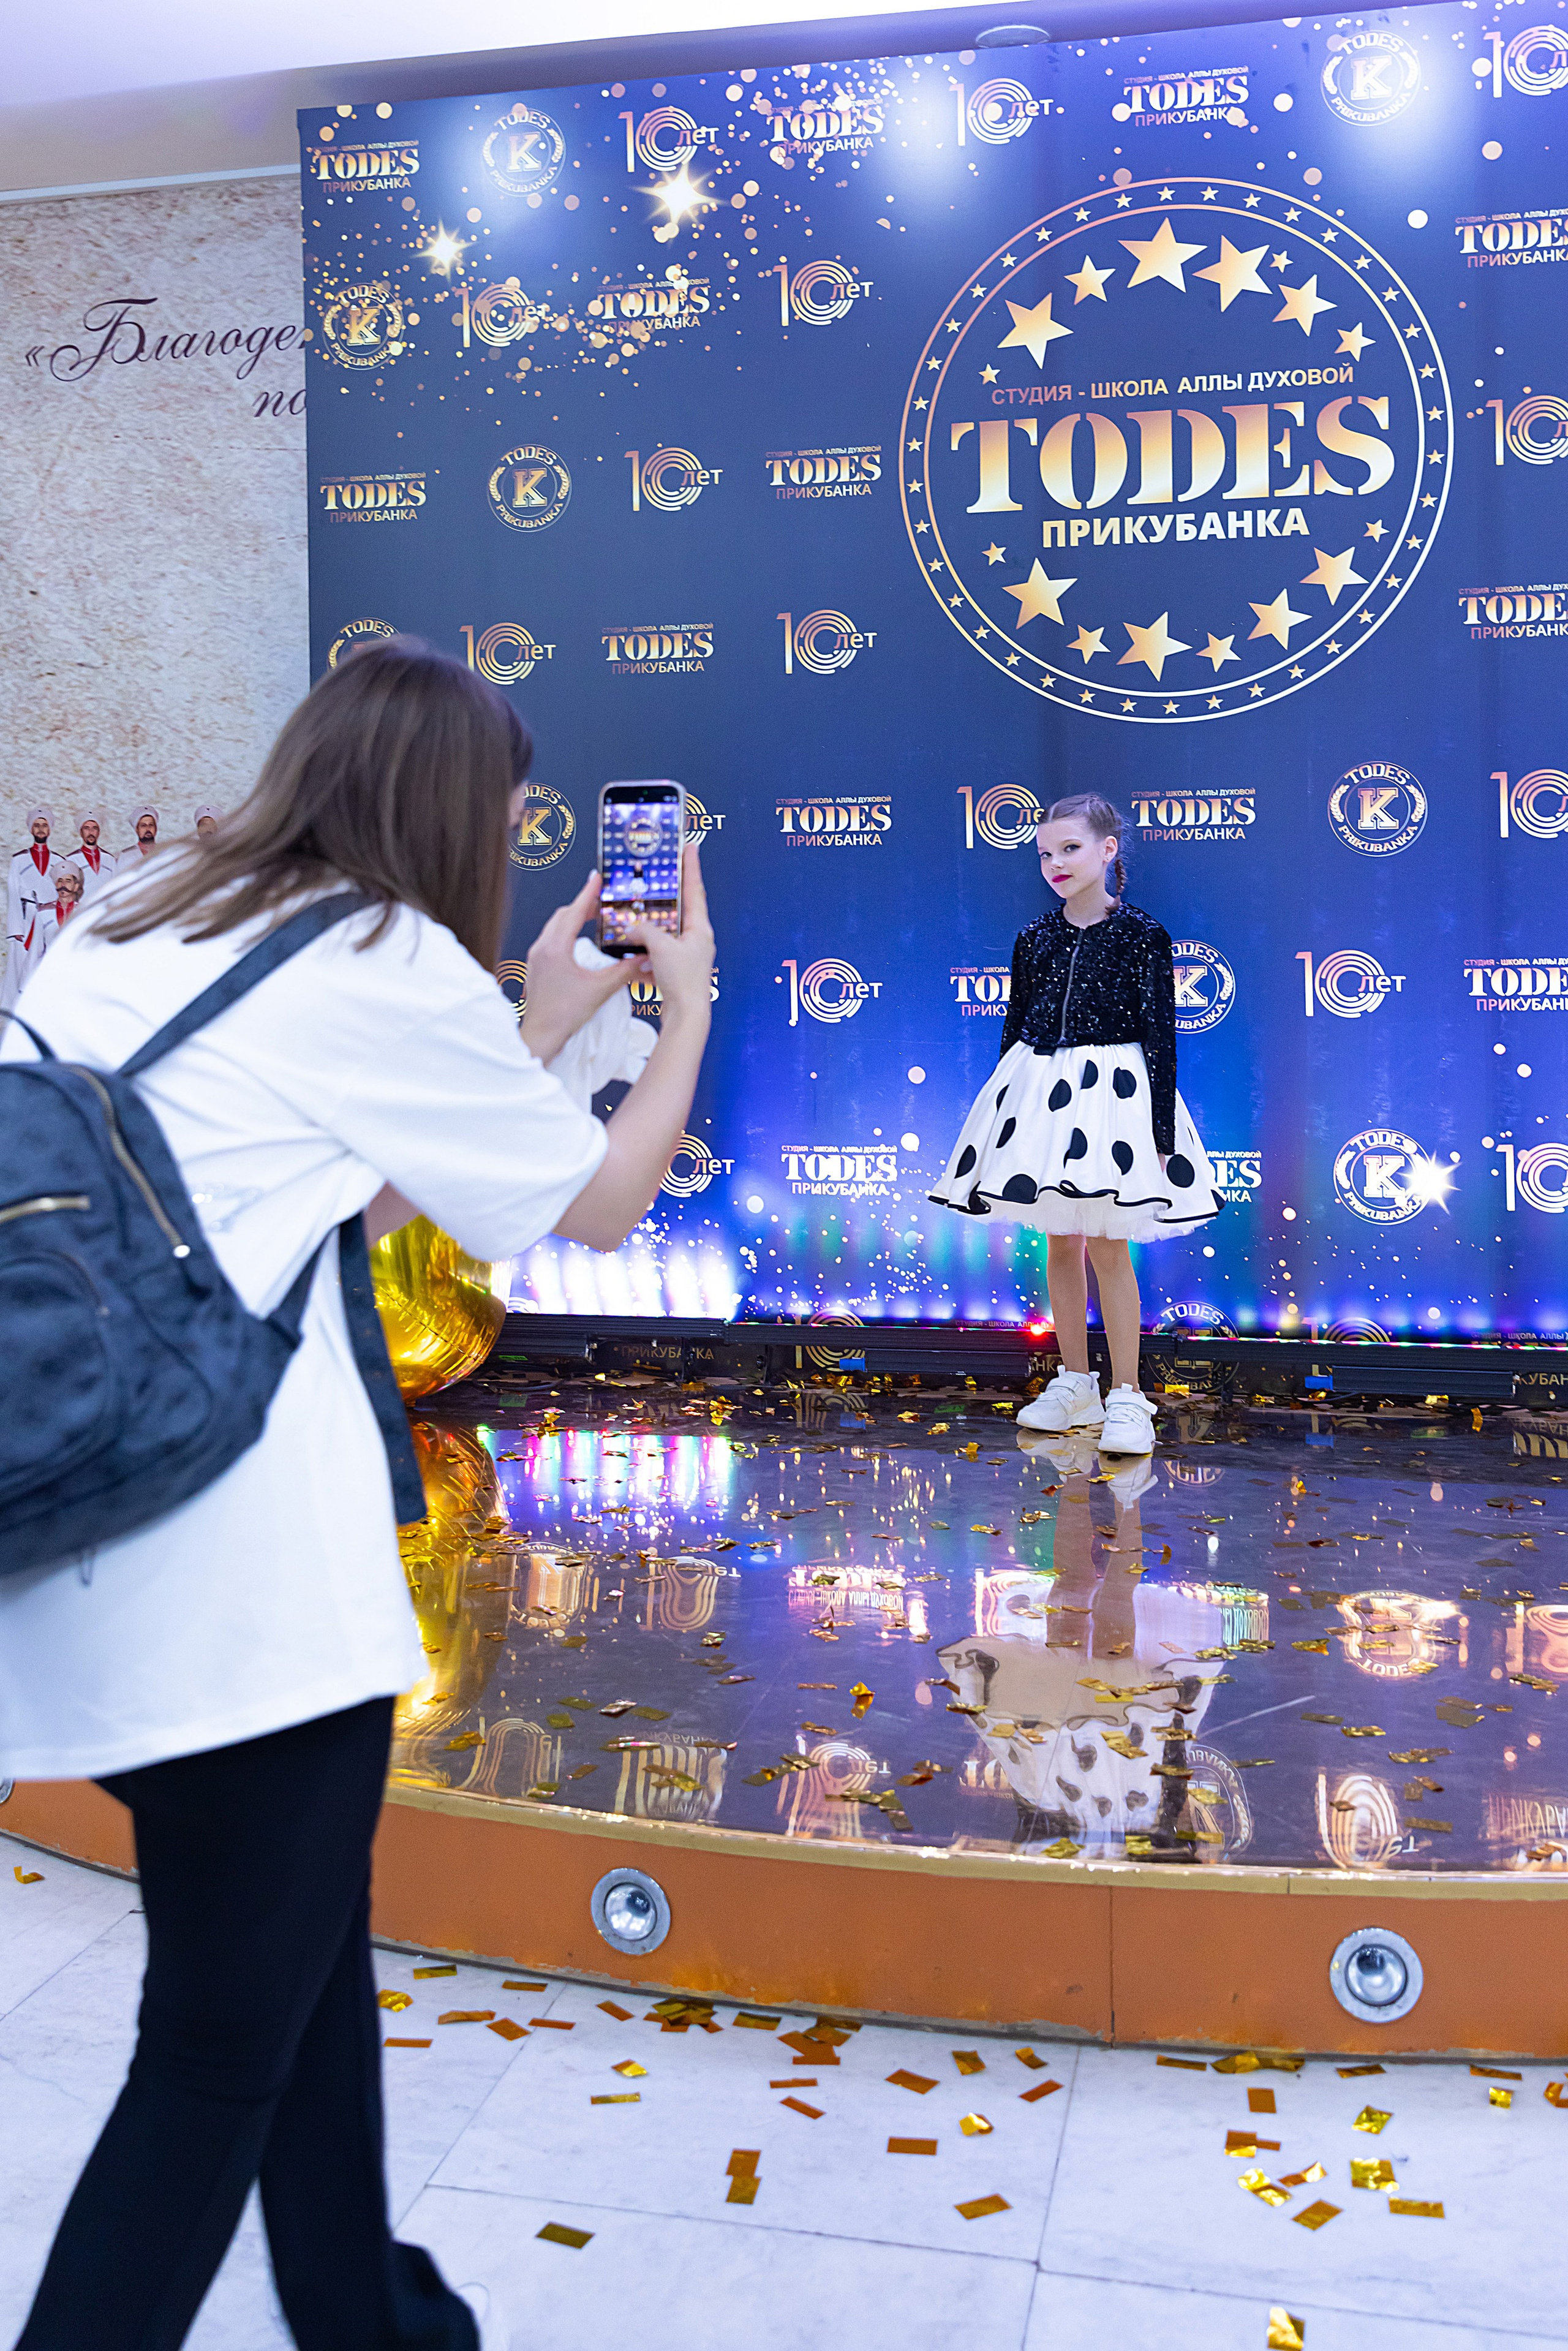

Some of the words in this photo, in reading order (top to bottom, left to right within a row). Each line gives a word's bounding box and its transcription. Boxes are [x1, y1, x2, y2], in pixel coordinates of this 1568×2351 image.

[1338, 32, 1403, 55] TODES
[1123, 75, 1250, 113] TODES
[1330, 93, 1411, 121] PRIKUBANKA
[766, 105, 884, 142] TODES
[1135, 107, 1231, 127] ПРИКУБАНК
[312, 148, 420, 180] TODES
[323, 177, 412, 193] ПРИКУБАНКА
[490, 165, 559, 192] PRIKUBANKA
[1455, 218, 1568, 254] TODE
[597, 287, 710, 319] TODES
[991, 384, 1073, 406] СТУДИЯ
[1091, 377, 1169, 399] ШКОЛА
[1177, 373, 1243, 394] АЛЛЫ
[1247, 363, 1354, 393] ДУХОВОЙ
[500, 446, 557, 466] TODES
[950, 395, 1395, 514] TODES
[766, 455, 882, 486] TODES
[320, 481, 426, 510] TODES
[776, 484, 872, 500] ПРИКУБАНКА
[331, 509, 418, 523] ПРИКУБАНКА
[496, 502, 564, 529] PRIKUBANKA
[1042, 507, 1310, 548] ПРИКУБАНКА
[340, 619, 394, 638] TODES
[601, 632, 714, 661] TODES
[612, 660, 705, 675] ПРИКУБАНКА
[1344, 763, 1411, 785] TODES
[858, 794, 892, 804] ДУХОВОЙ
[1219, 788, 1256, 798] ДУХОВОЙ
[775, 804, 892, 833] TODES
[1131, 797, 1256, 826] TODES
[786, 833, 883, 847] ПРИКУБАНКА
[1143, 827, 1246, 842] ПРИКУБАНКА
[1338, 825, 1419, 853] PRIKUBANKA
[1476, 997, 1568, 1011] ПРИКУБАН
[781, 1153, 898, 1183] TODES
[792, 1182, 889, 1197] ПРИКУБАНКА
[1161, 1303, 1224, 1325] TODES
